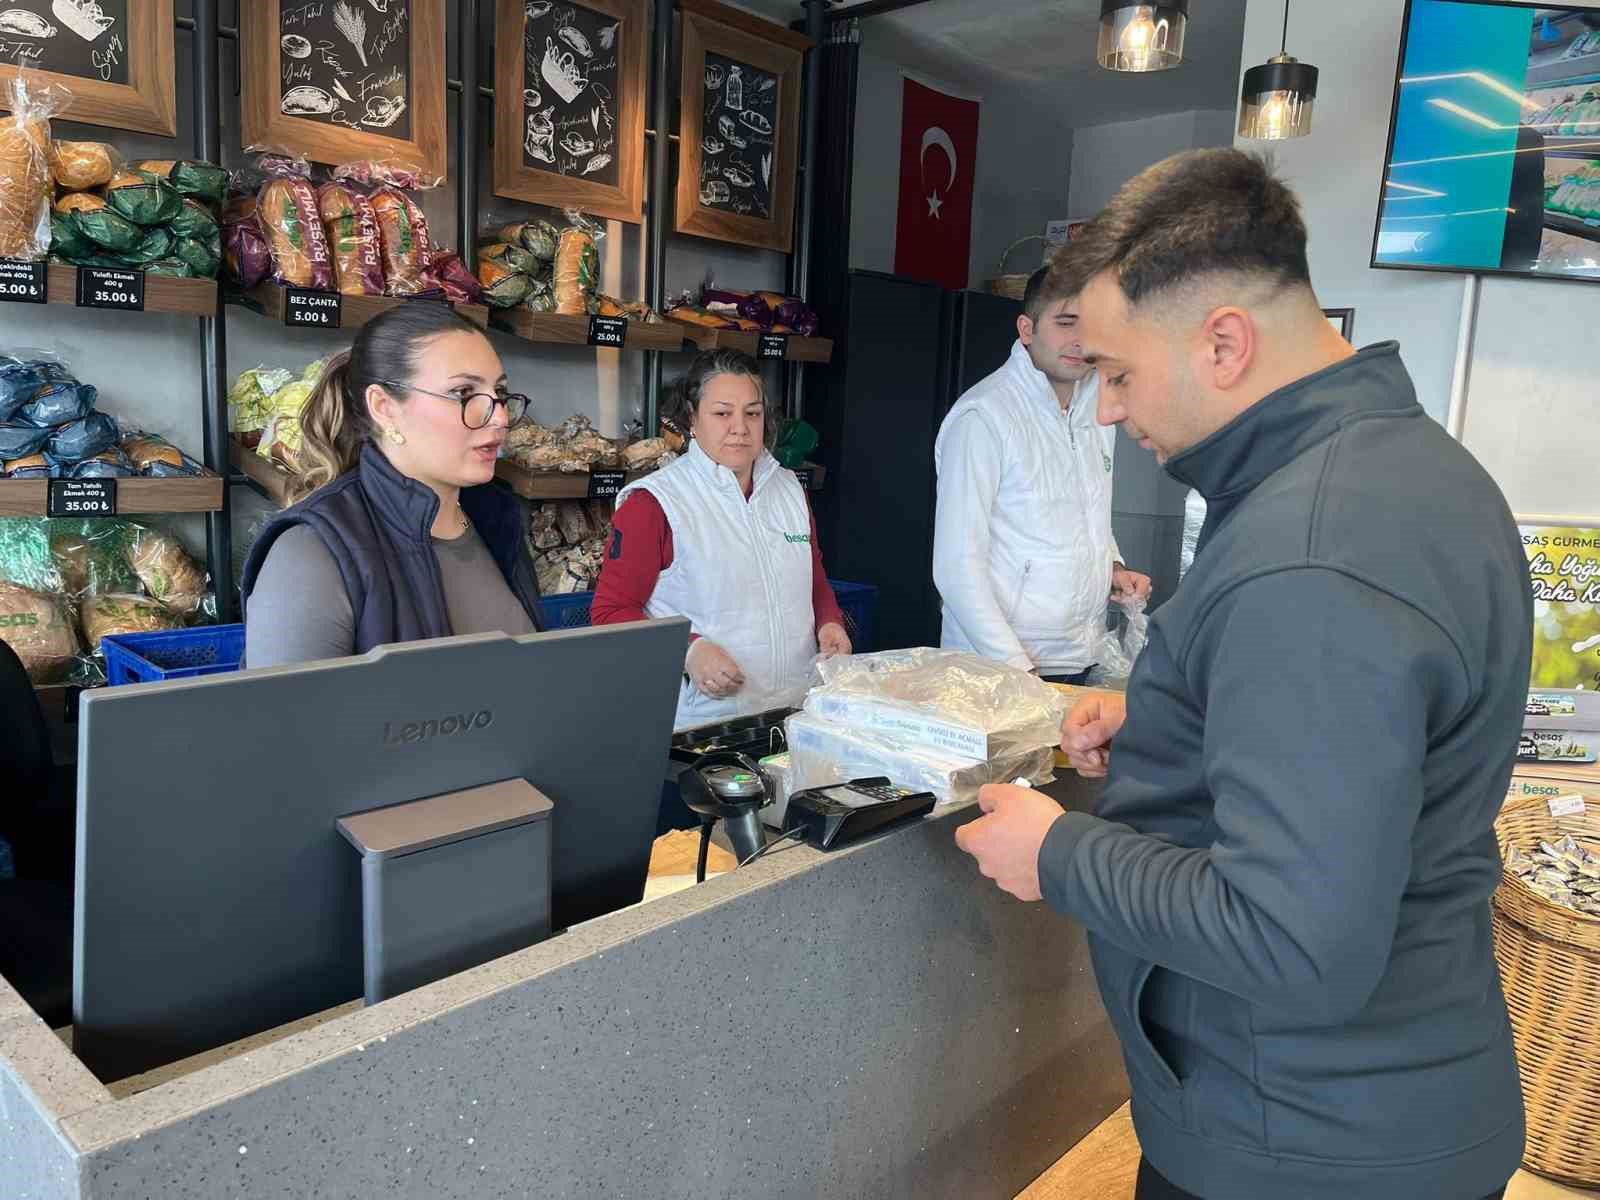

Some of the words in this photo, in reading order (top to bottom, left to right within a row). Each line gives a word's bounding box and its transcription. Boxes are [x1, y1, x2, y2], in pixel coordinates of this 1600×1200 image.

[95, 291, 128, 303] 35.00
[290, 296, 307, 305] BEZ
[308, 297, 338, 308] ÇANTA
[295, 311, 319, 322] 5.00
[65, 501, 99, 511] 35.00
[382, 709, 493, 744] Lenovo
